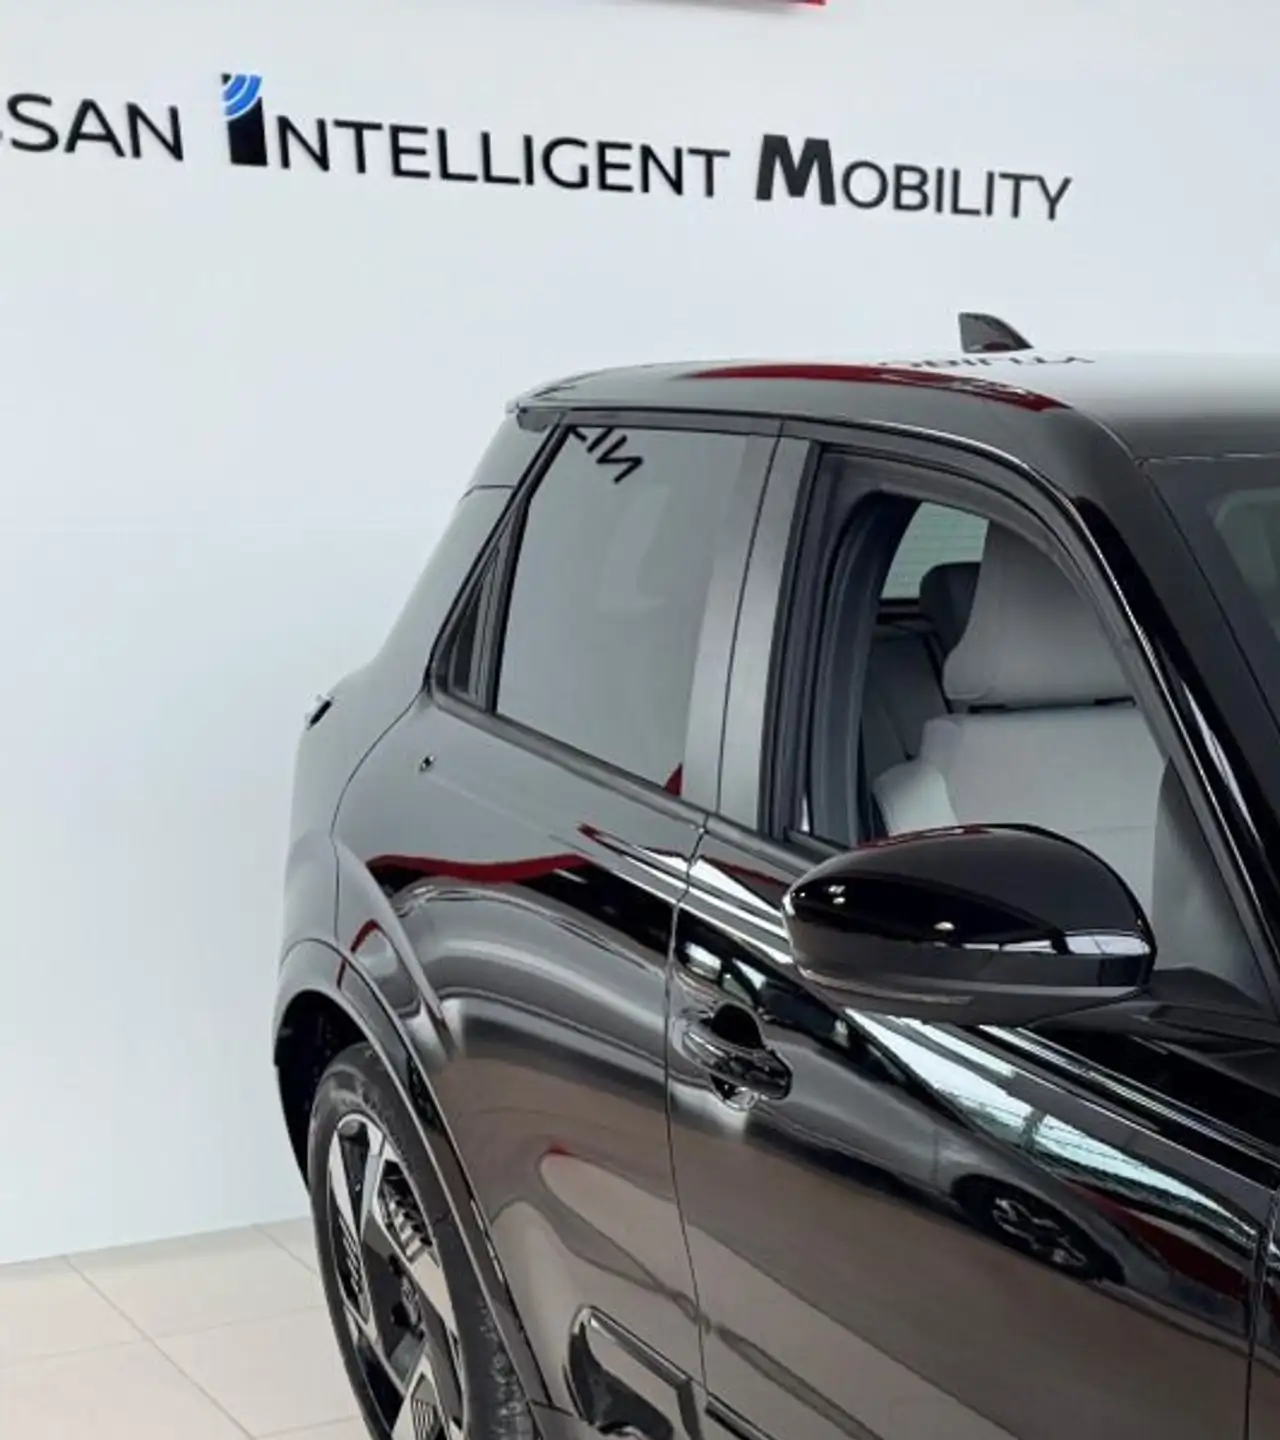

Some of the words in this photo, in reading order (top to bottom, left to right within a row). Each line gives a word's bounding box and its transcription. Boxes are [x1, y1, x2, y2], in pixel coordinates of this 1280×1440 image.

[0, 93, 183, 161] SAN
[221, 73, 730, 198] INTELLIGENT
[756, 134, 1072, 220] MOBILITY
